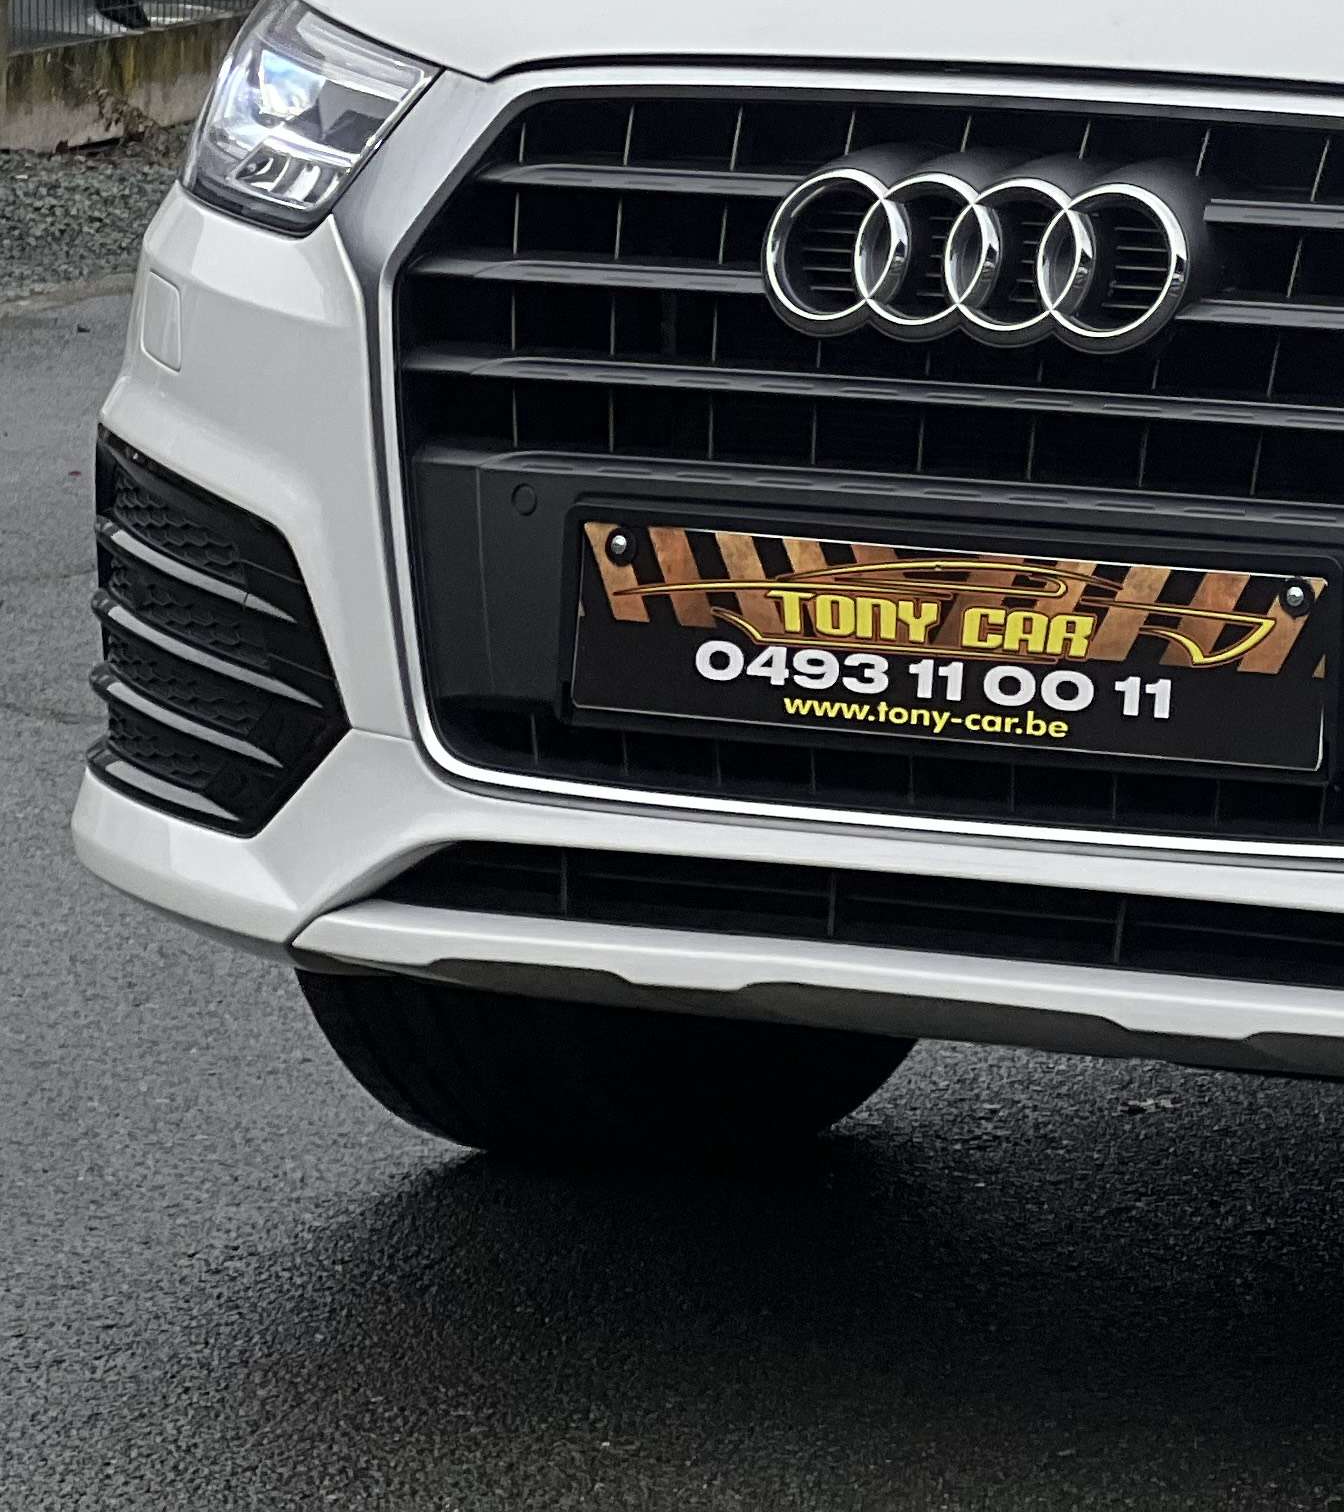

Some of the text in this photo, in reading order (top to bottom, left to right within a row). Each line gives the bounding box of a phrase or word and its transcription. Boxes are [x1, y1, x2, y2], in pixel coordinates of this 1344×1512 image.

[766, 589, 1097, 659] TONY CAR
[694, 638, 1173, 720] 0493 11 00 11
[783, 695, 1070, 739] www.tony-car.be
